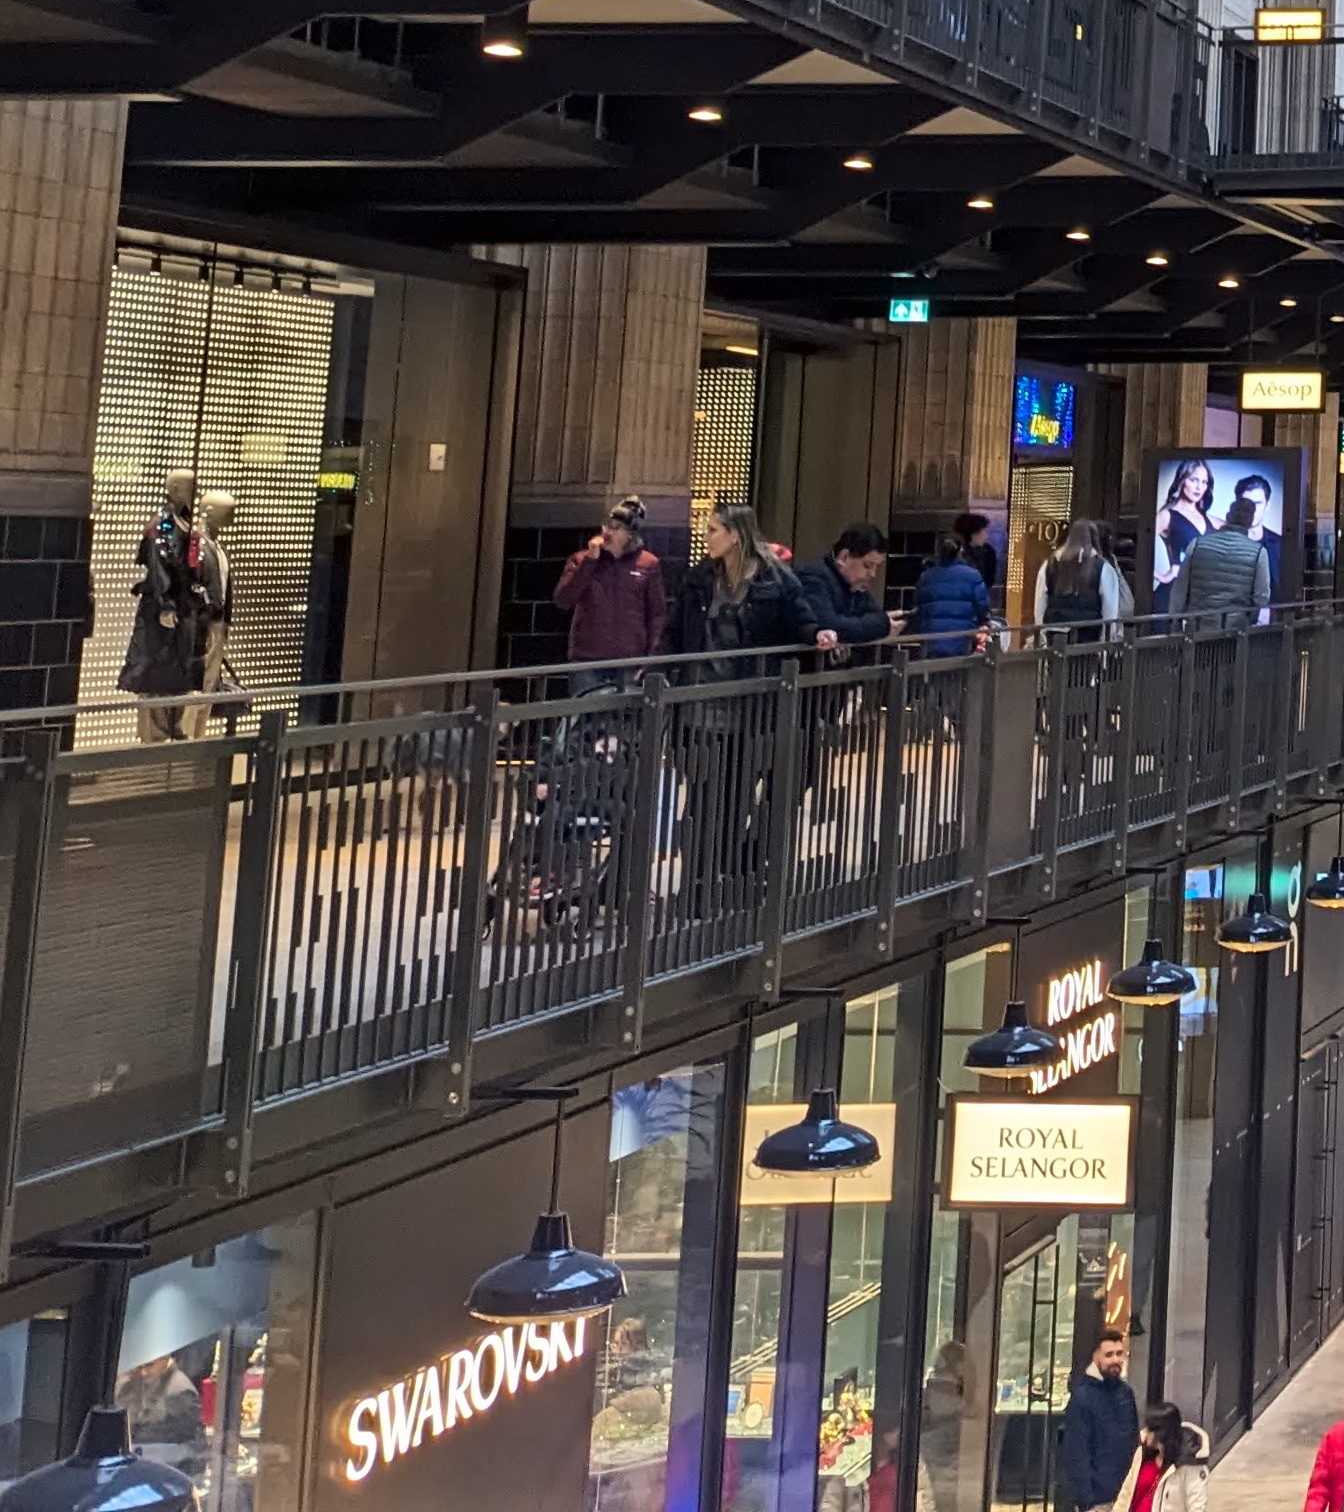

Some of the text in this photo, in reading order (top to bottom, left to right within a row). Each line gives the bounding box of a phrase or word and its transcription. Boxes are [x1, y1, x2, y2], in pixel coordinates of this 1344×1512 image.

[1048, 960, 1103, 1026] ROYAL
[999, 1127, 1083, 1149] ROYAL
[970, 1156, 1107, 1179] SELANGOR
[346, 1317, 586, 1482] SWAROVSKI
